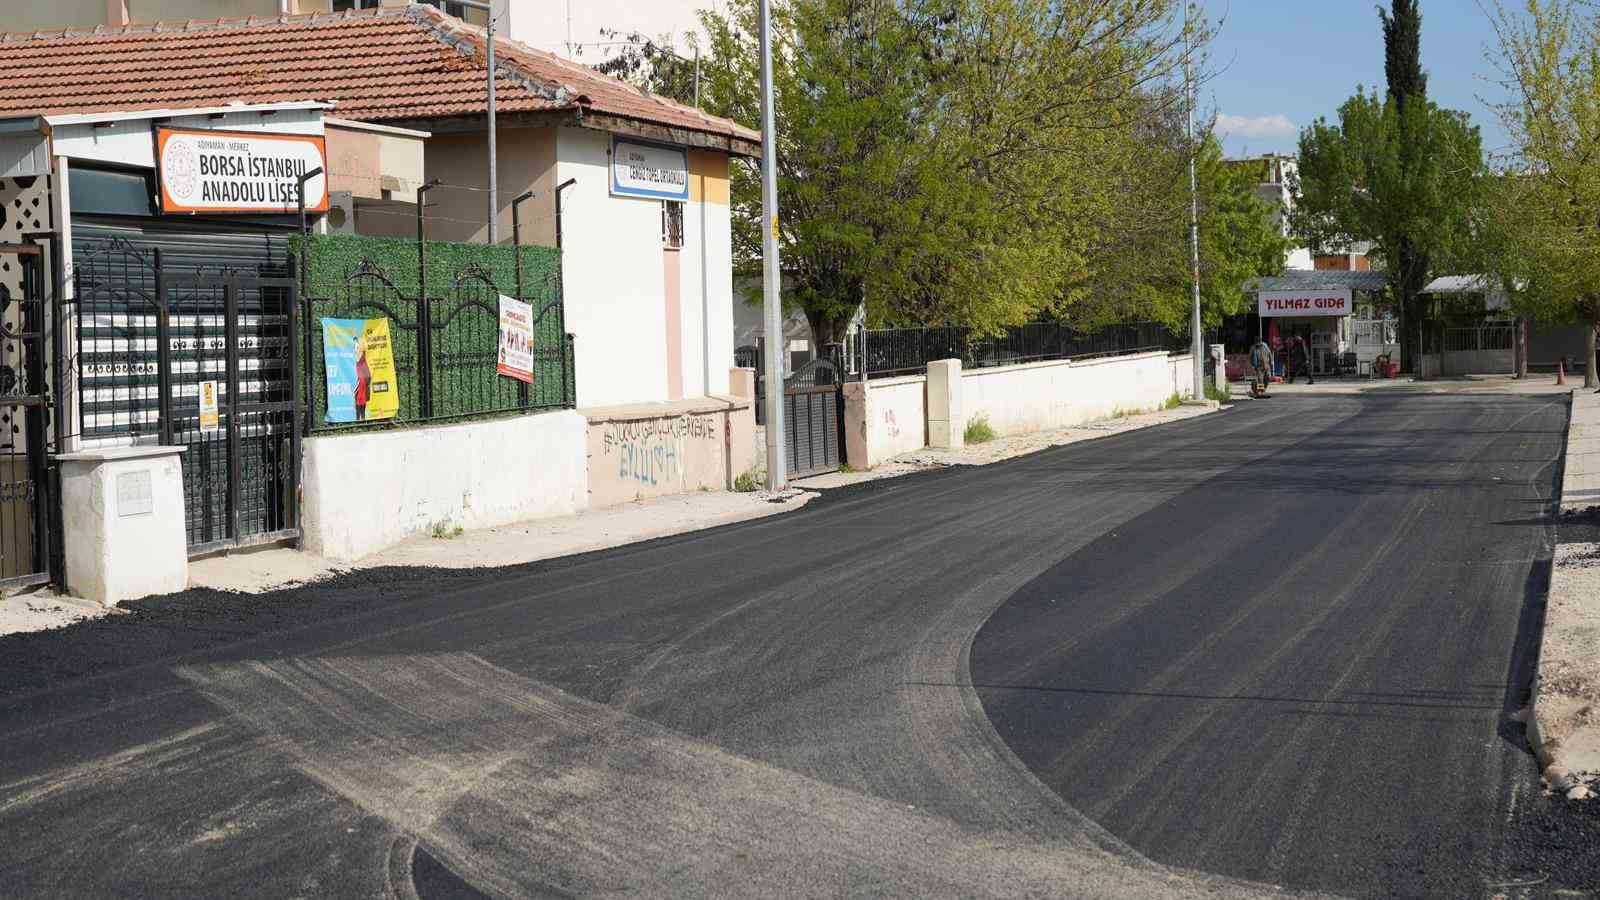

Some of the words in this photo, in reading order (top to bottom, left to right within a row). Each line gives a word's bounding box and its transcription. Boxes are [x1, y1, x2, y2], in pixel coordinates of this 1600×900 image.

[230, 143, 249, 152] MERKEZ
[200, 154, 245, 177] BORSA
[202, 181, 265, 203] ANADOLU
[269, 178, 302, 203] LİSES
[1265, 298, 1311, 310] YILMAZ
[1314, 298, 1345, 309] GIDA
